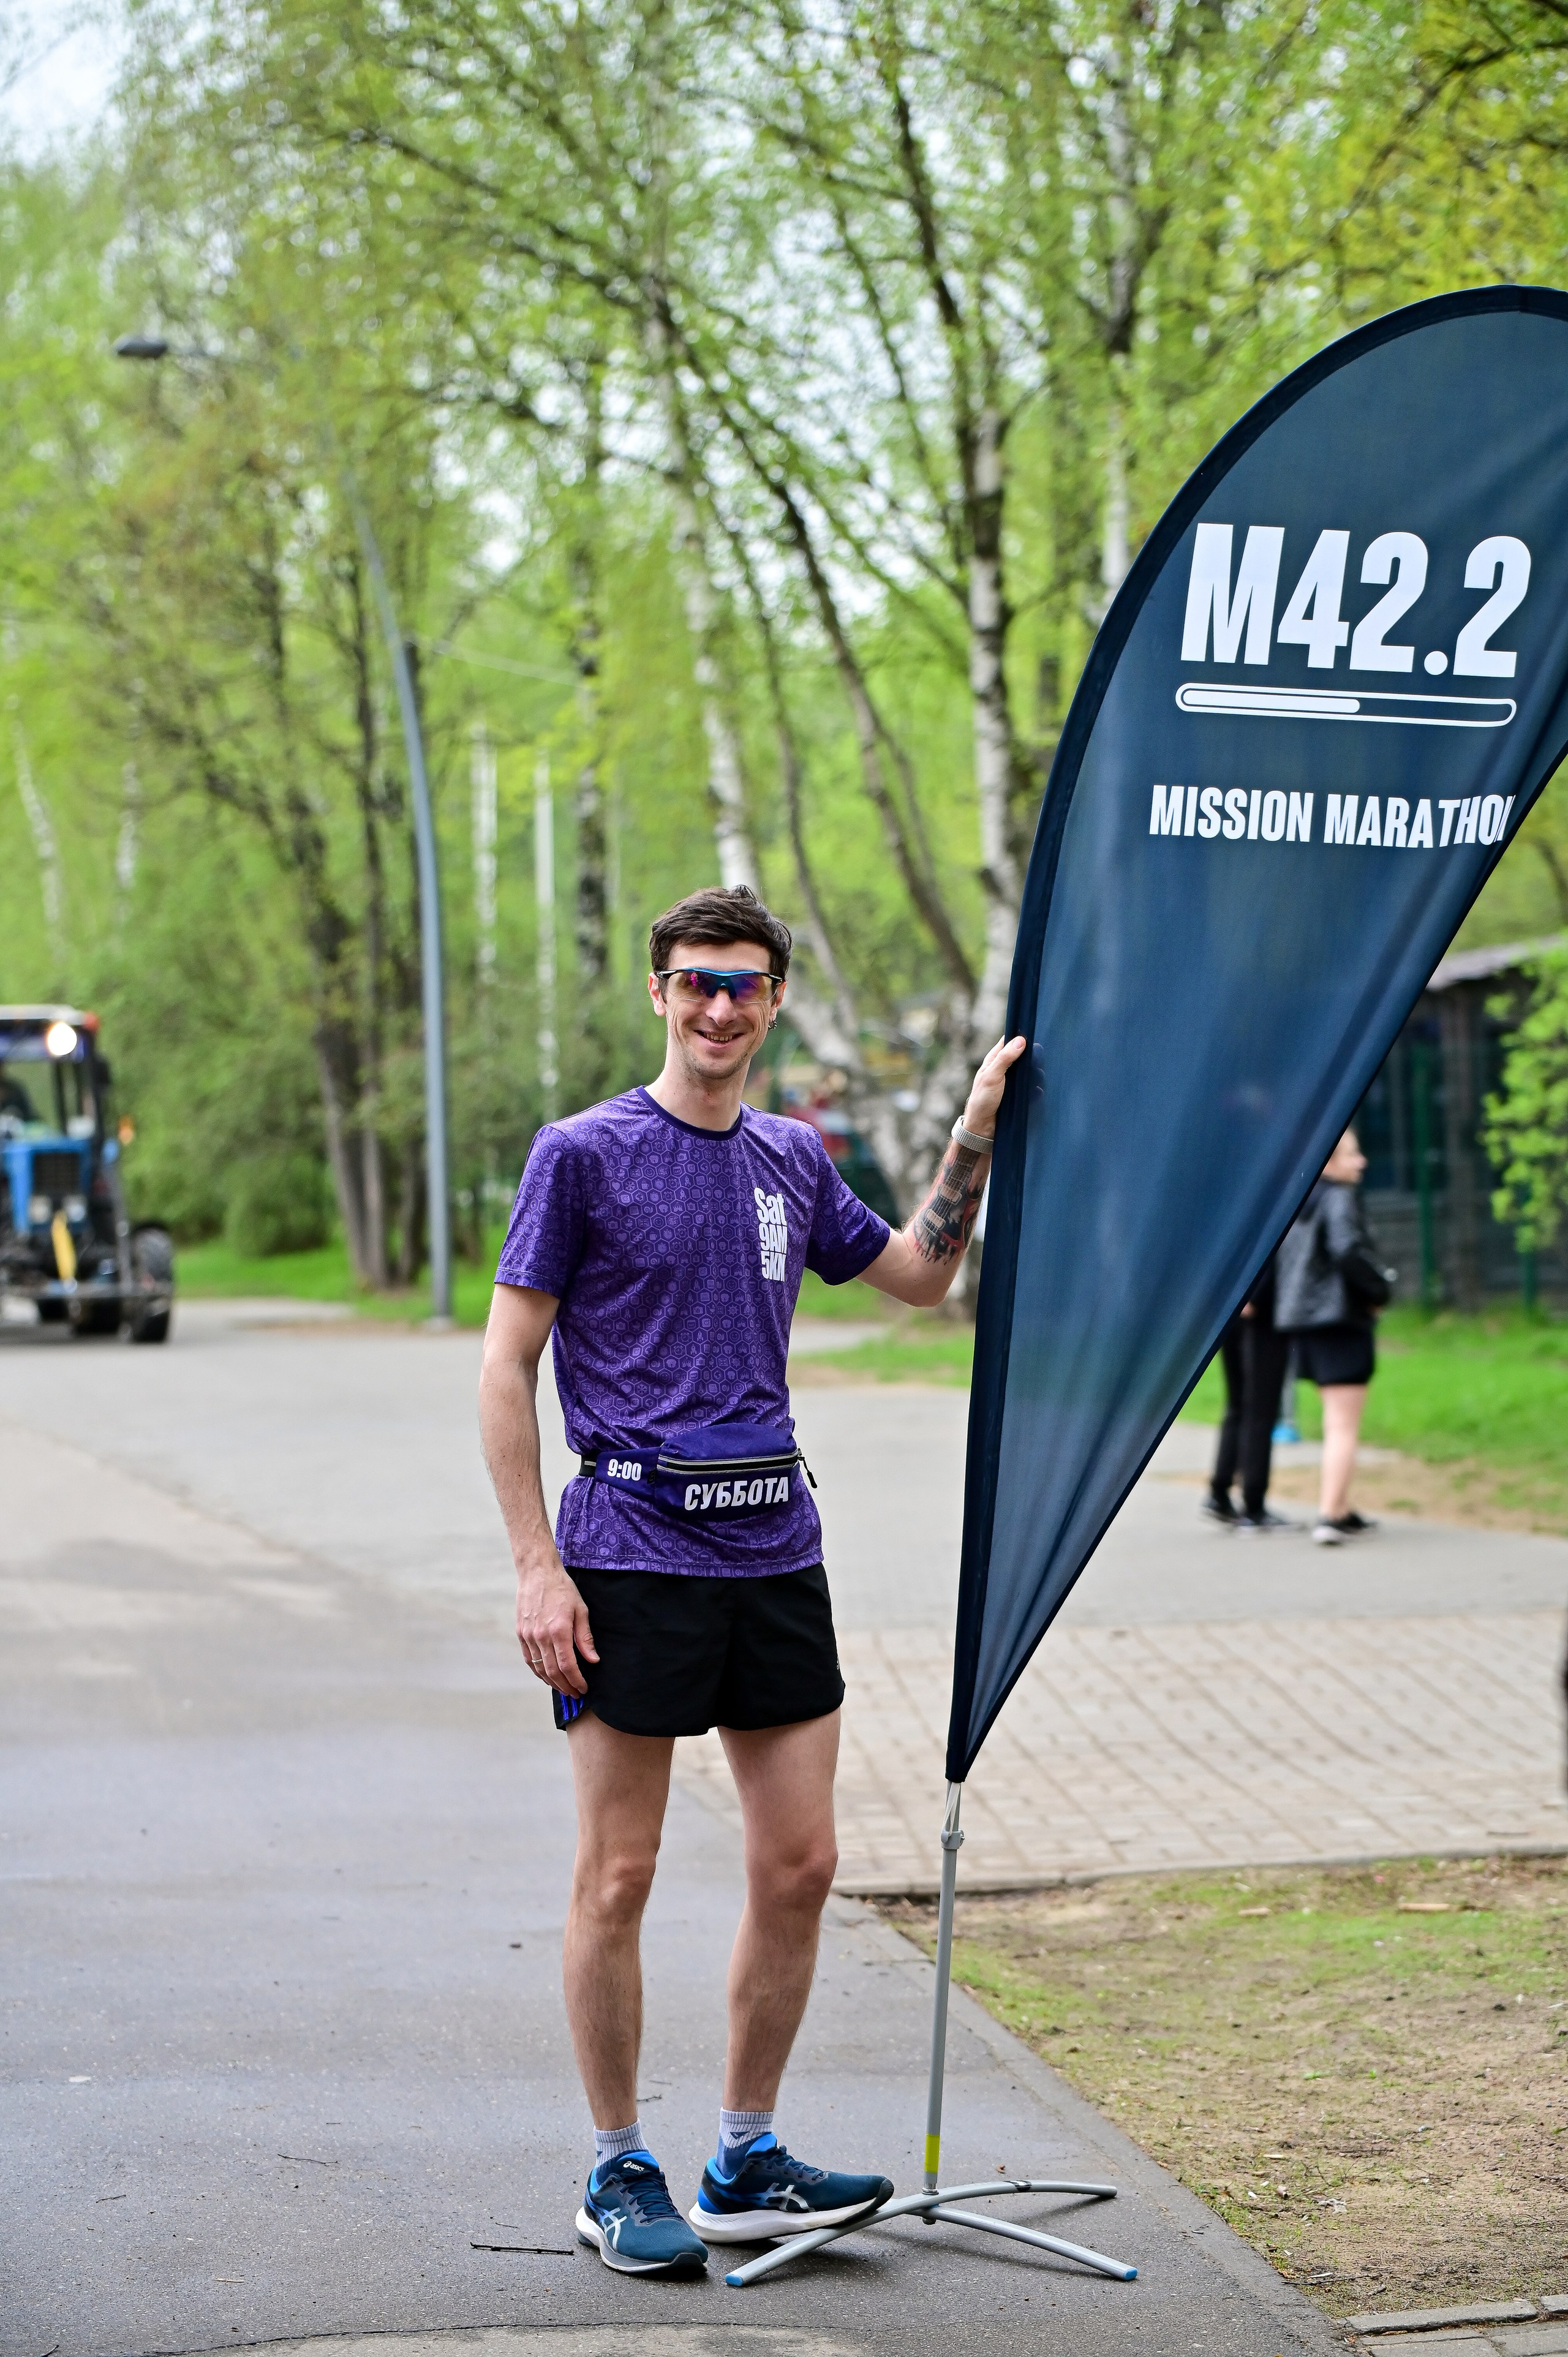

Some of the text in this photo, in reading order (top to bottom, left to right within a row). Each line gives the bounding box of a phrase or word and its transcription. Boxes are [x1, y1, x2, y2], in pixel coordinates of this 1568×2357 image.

[1180, 522, 1531, 678] M42.2
[1149, 785, 1314, 843] MISSION
[753, 1187, 787, 1226] Sat
[758, 1223, 788, 1254] 9AM
[607, 1458, 642, 1481] 9:00
[684, 1477, 788, 1510] СУББОТА
